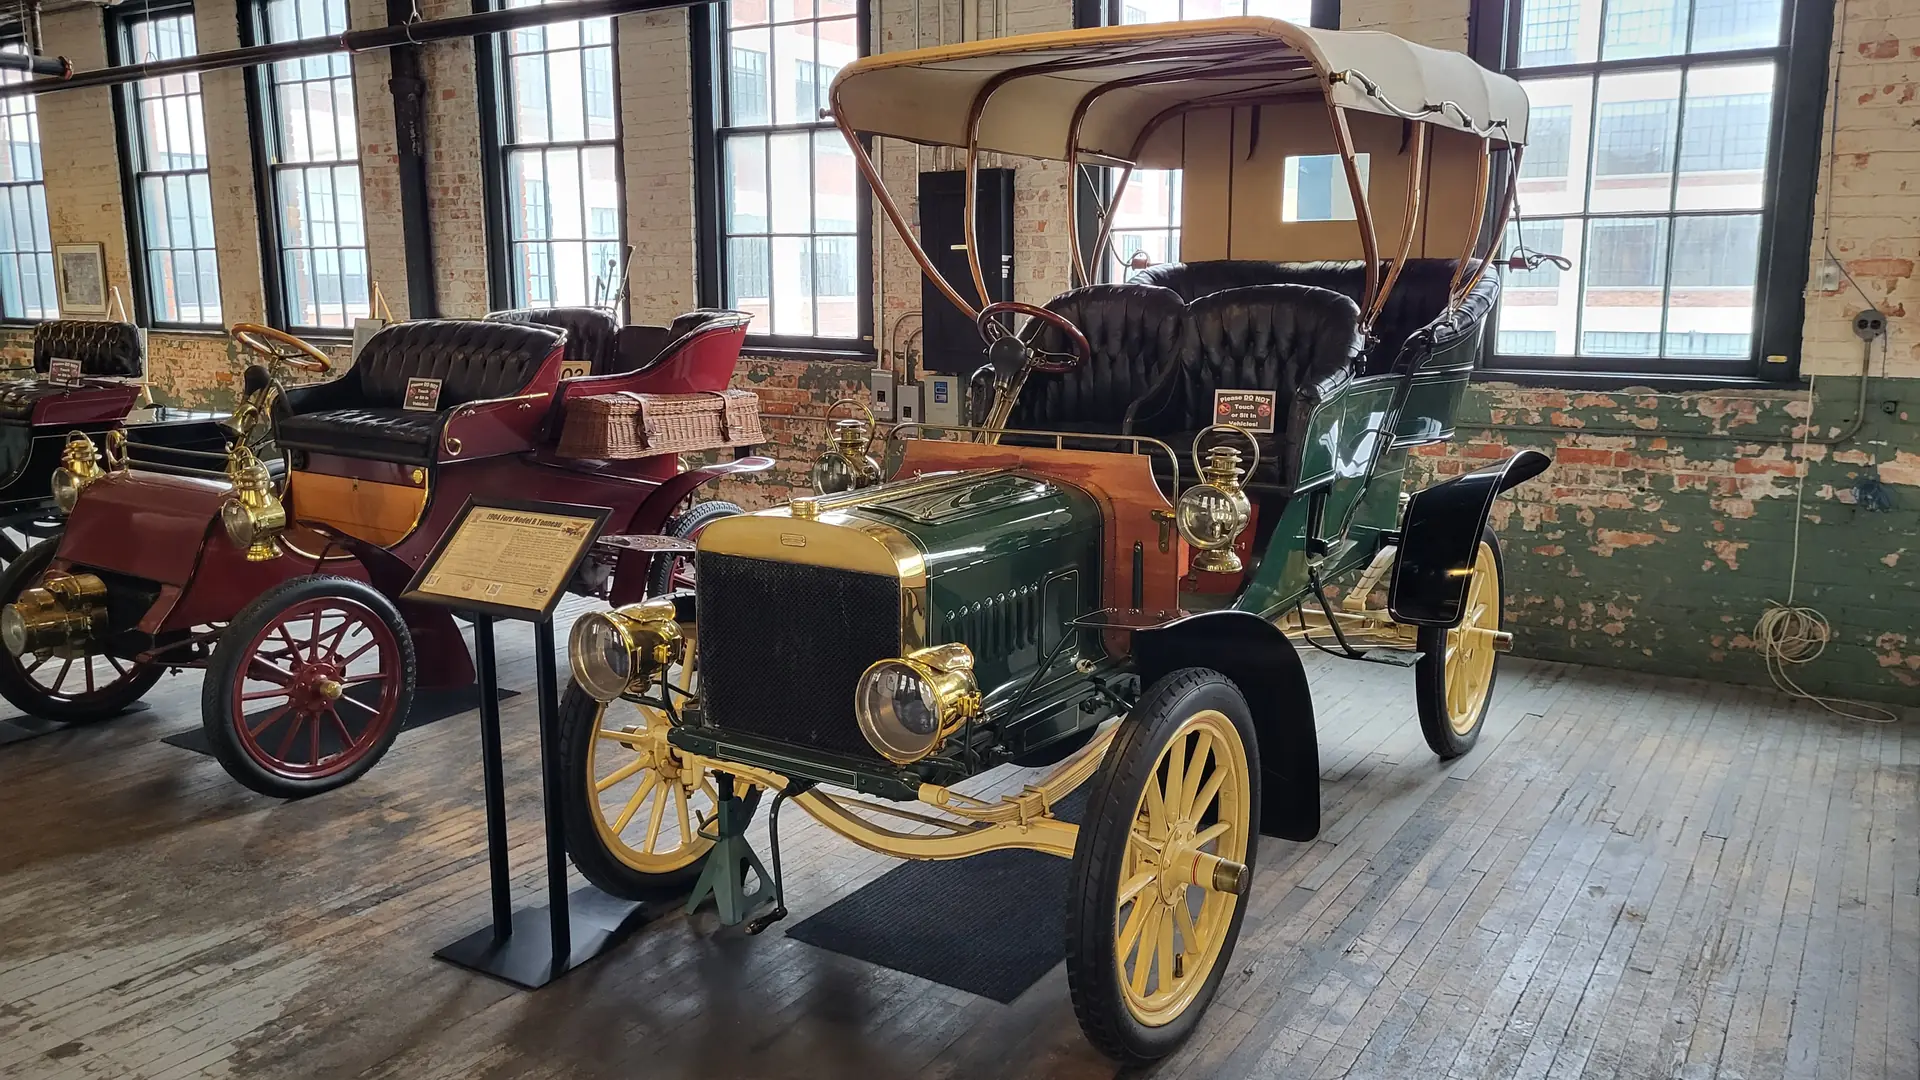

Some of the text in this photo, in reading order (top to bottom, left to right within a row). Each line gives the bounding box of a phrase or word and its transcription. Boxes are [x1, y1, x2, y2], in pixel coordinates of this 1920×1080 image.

[1255, 396, 1270, 404] NOT
[512, 516, 534, 524] Model
[536, 519, 563, 528] Tonneau
